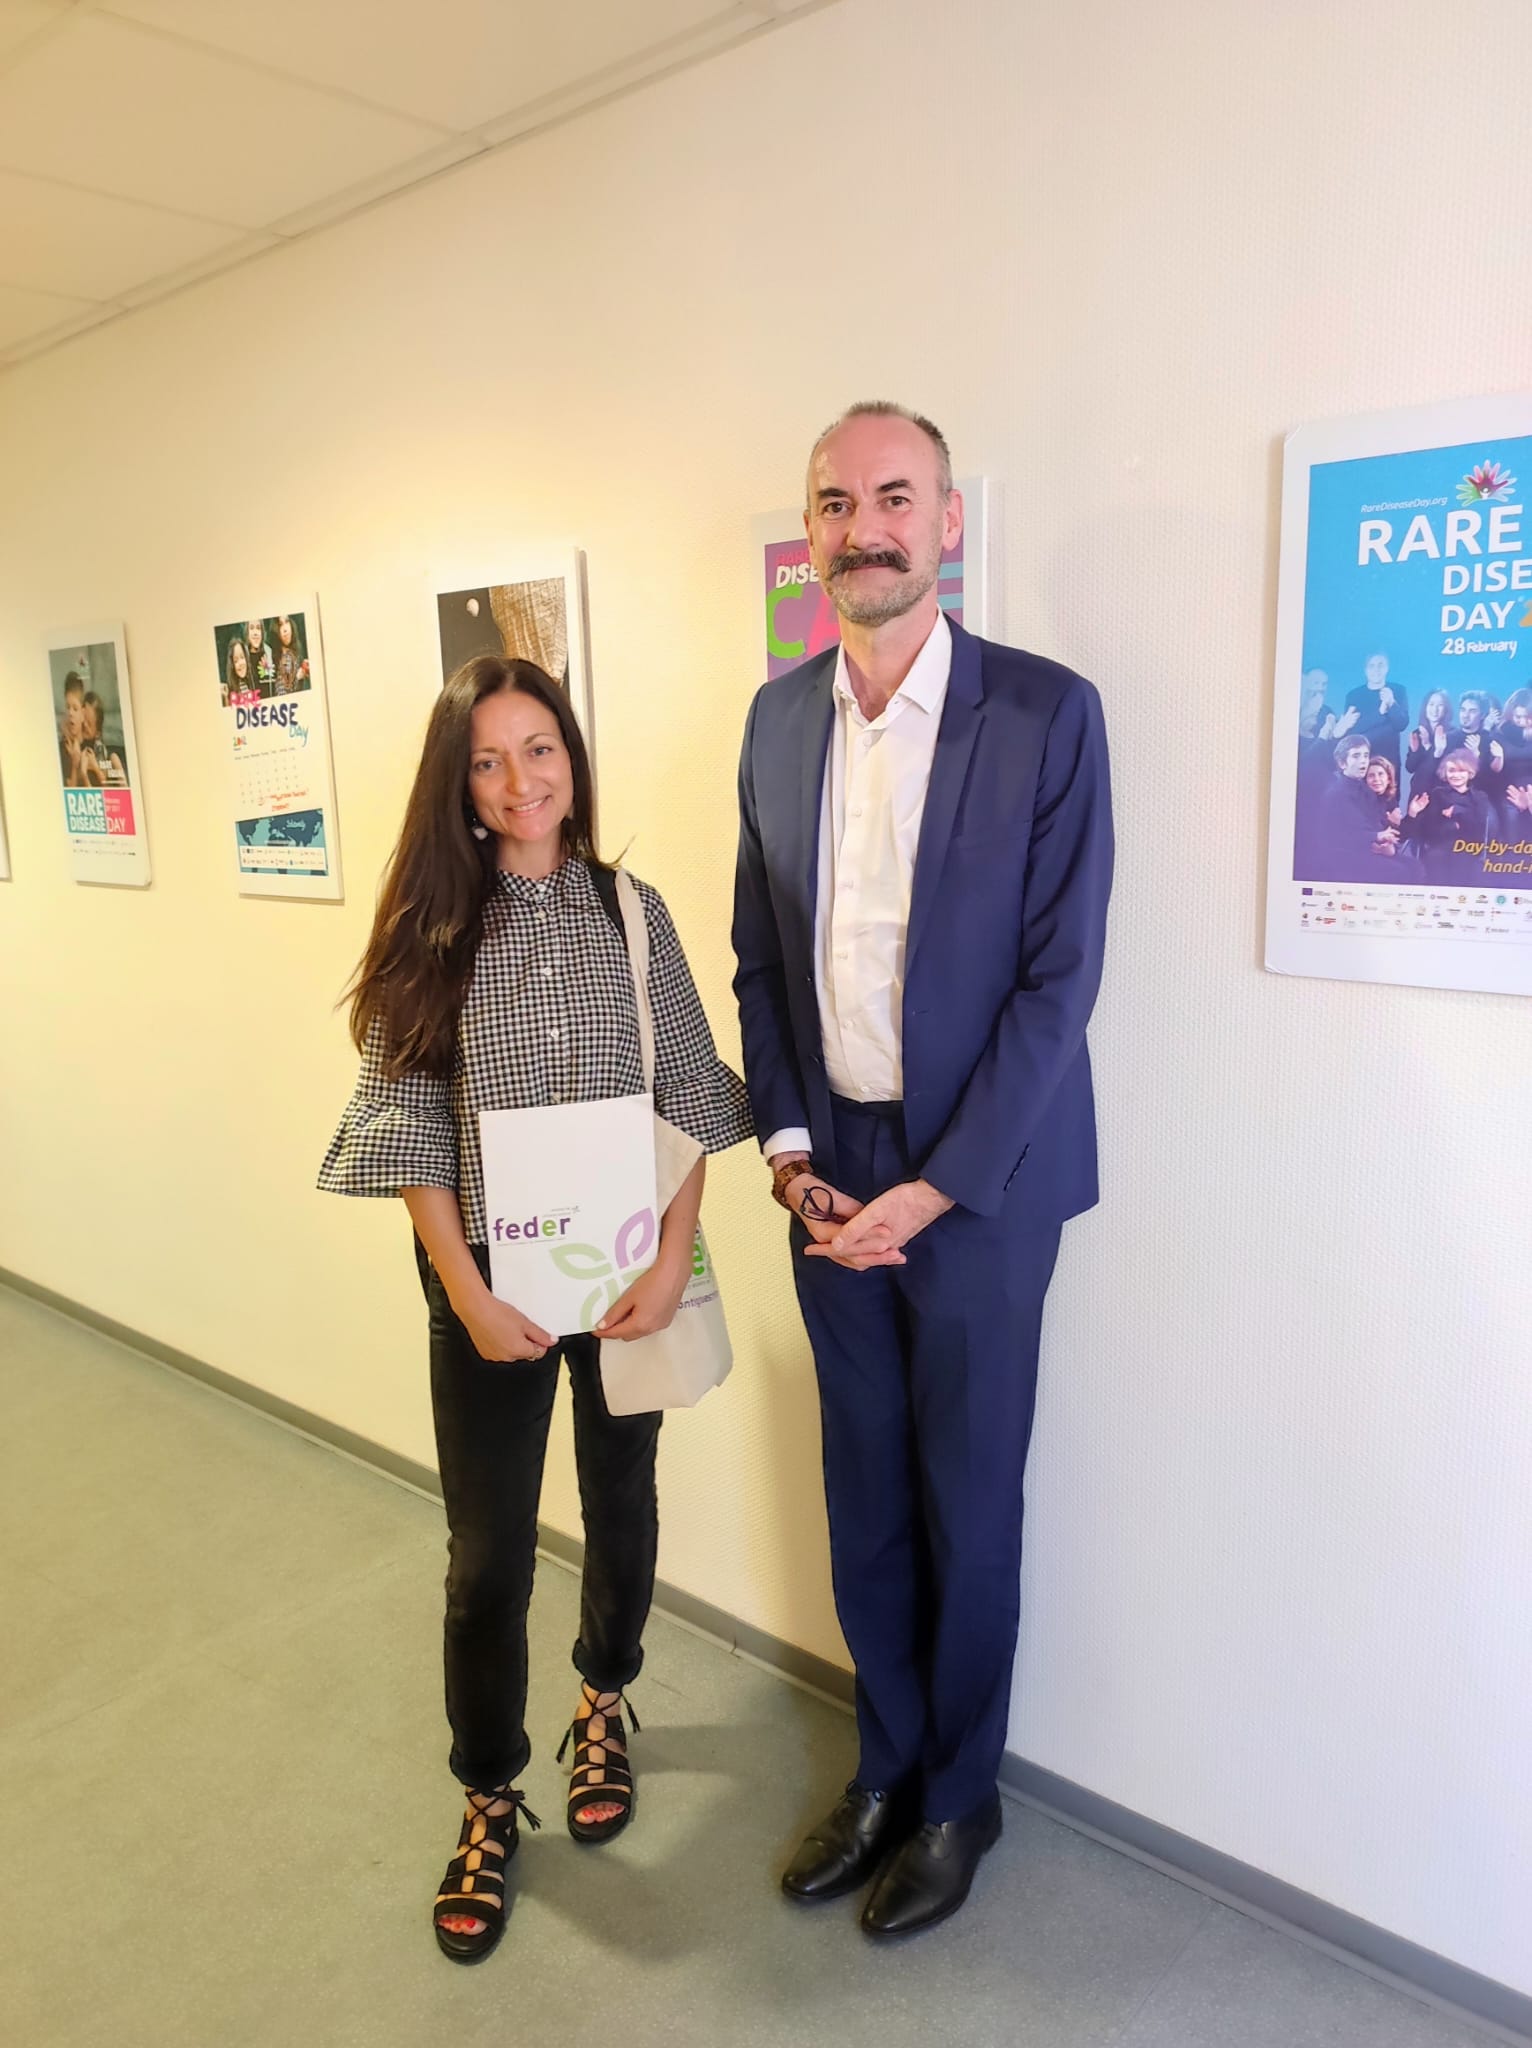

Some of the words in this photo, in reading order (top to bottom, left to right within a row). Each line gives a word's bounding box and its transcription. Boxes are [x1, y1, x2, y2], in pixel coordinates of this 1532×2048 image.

[1360, 497, 1449, 513] RareDiseaseDay.org
[1358, 504, 1523, 566] RARE
[1442, 559, 1532, 595] DISE
[1440, 600, 1516, 632] DAY
[1441, 637, 1465, 655] 28
[1467, 640, 1518, 659] February
[236, 703, 298, 730] DISEASE
[66, 793, 105, 816] RARE
[70, 815, 107, 832] DISEASE
[107, 816, 127, 833] DAY
[1453, 839, 1532, 856] Day-by-da
[492, 1215, 571, 1242] feder
